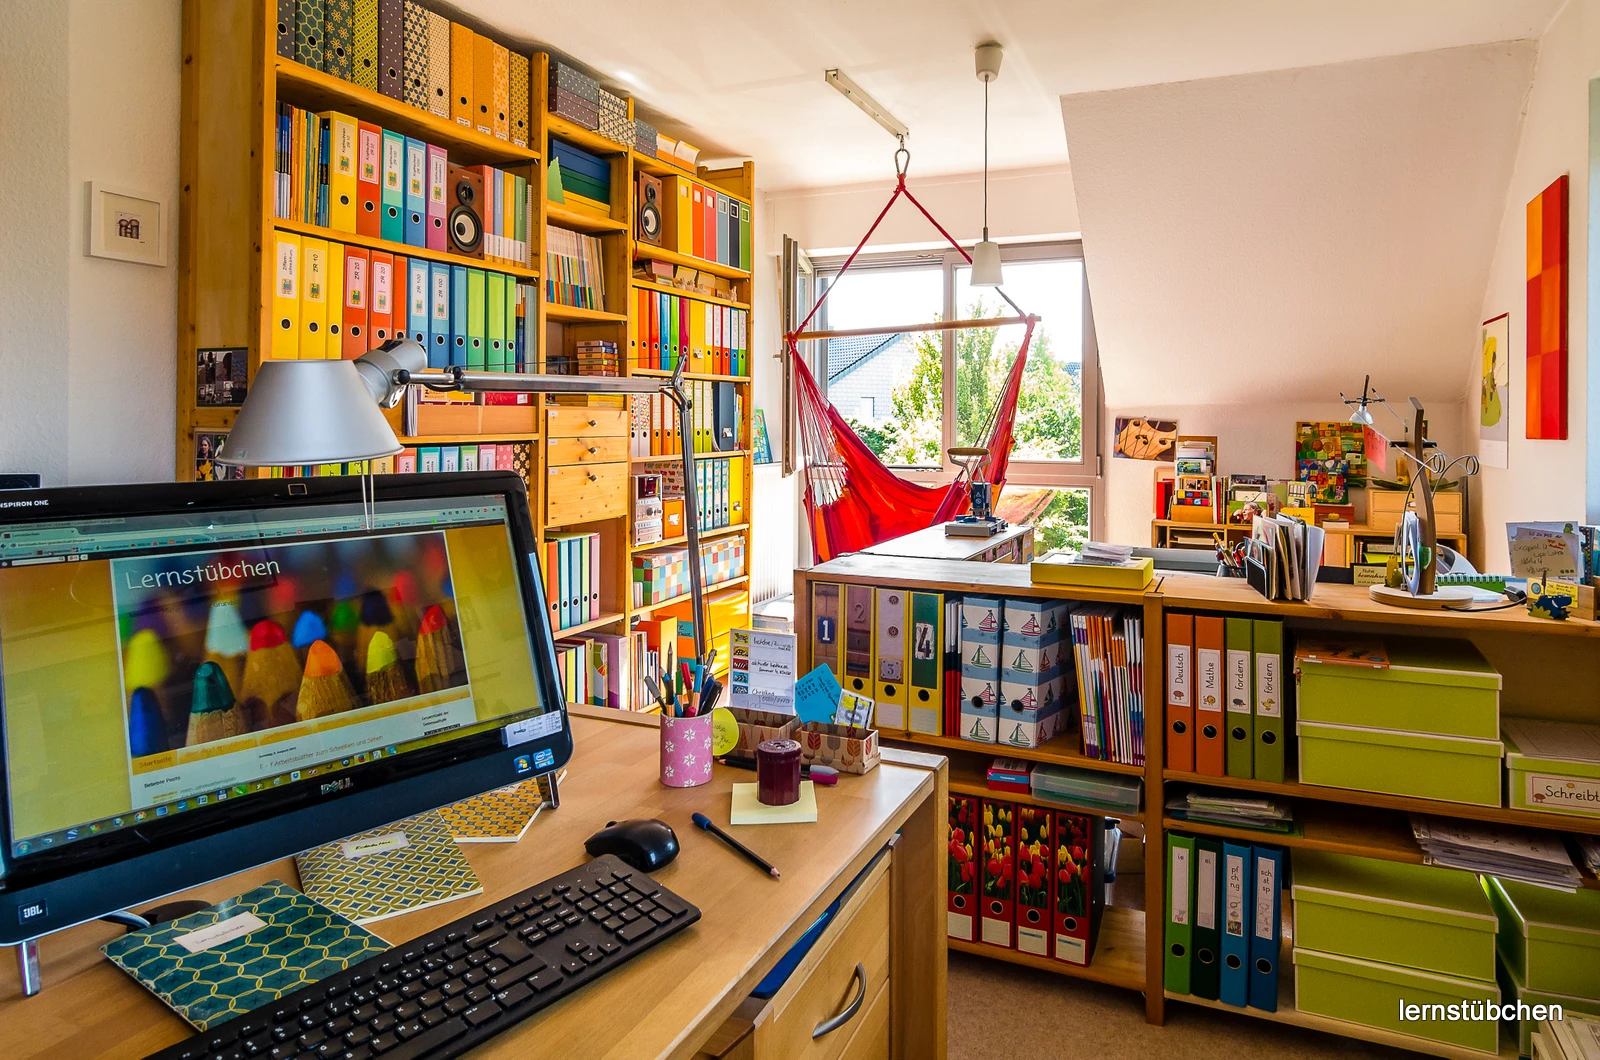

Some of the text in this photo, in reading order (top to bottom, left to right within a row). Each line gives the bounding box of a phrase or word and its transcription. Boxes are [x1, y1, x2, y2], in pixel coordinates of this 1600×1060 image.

[313, 253, 319, 273] ZR 10
[354, 262, 360, 281] ZR 20
[380, 266, 385, 284] ZR 20
[416, 285, 422, 294] ZR
[438, 289, 443, 298] ZR
[125, 559, 281, 590] Lernstübchen
[854, 603, 866, 624] 2
[822, 619, 831, 642] 1
[917, 624, 932, 659] 4
[887, 663, 895, 676] 3
[1174, 652, 1184, 684] Deutsch
[1206, 662, 1214, 689] Mathe
[1234, 659, 1244, 691] fordern
[1263, 662, 1273, 694] fördern
[274, 752, 314, 767] Arbeitsblätter
[315, 748, 328, 757] zum
[329, 743, 356, 755] Schreiben
[356, 738, 367, 747] und
[368, 735, 384, 744] Sehen
[139, 756, 172, 769] Startseite
[144, 775, 181, 789] Beliebte Posts
[320, 776, 352, 795] DELL
[1545, 785, 1600, 802] Schreibt
[1177, 853, 1185, 861] ie
[1230, 873, 1239, 881] ch
[1231, 865, 1240, 875] pf
[1260, 869, 1273, 878] sch
[1230, 882, 1240, 892] ng
[1263, 876, 1270, 885] st
[1262, 886, 1271, 895] sp
[23, 904, 43, 918] JBL
